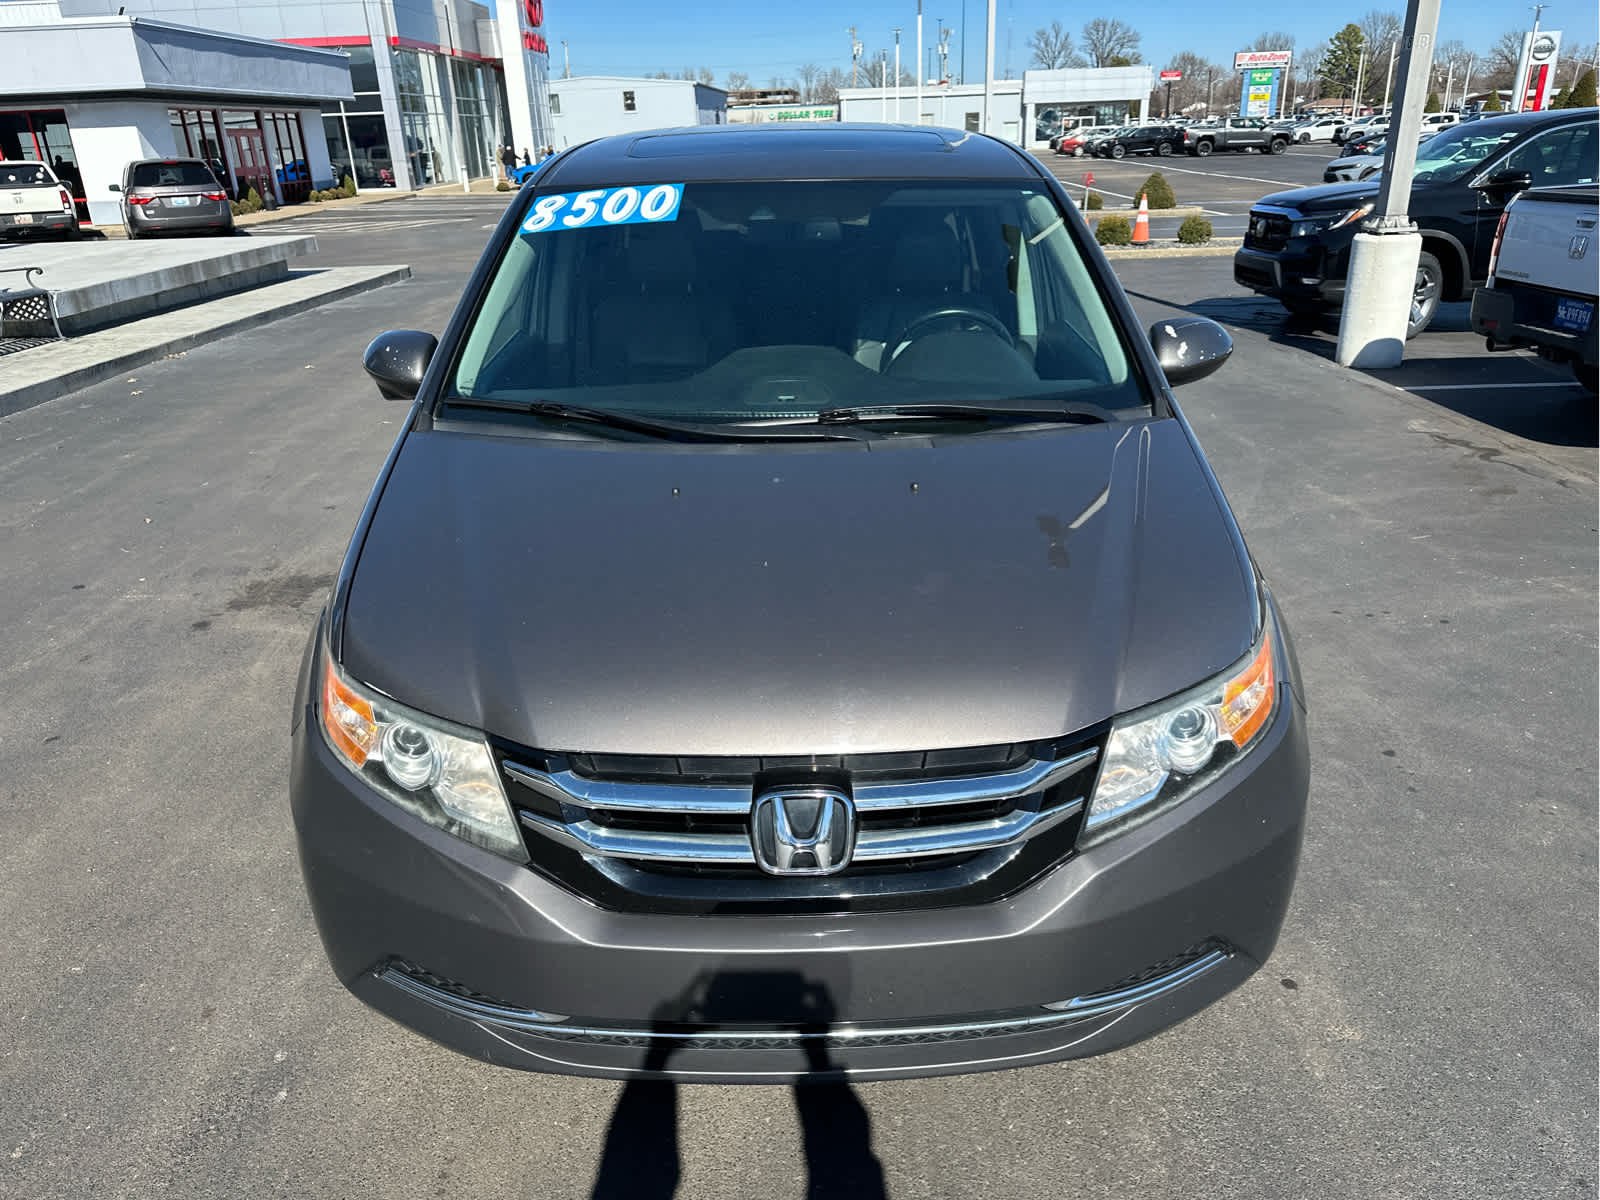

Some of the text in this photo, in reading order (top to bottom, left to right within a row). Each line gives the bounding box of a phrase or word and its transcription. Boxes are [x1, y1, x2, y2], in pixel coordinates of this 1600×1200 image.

[1248, 53, 1288, 61] AutoZone
[777, 109, 834, 120] DOLLAR TREE
[522, 185, 679, 231] 8500
